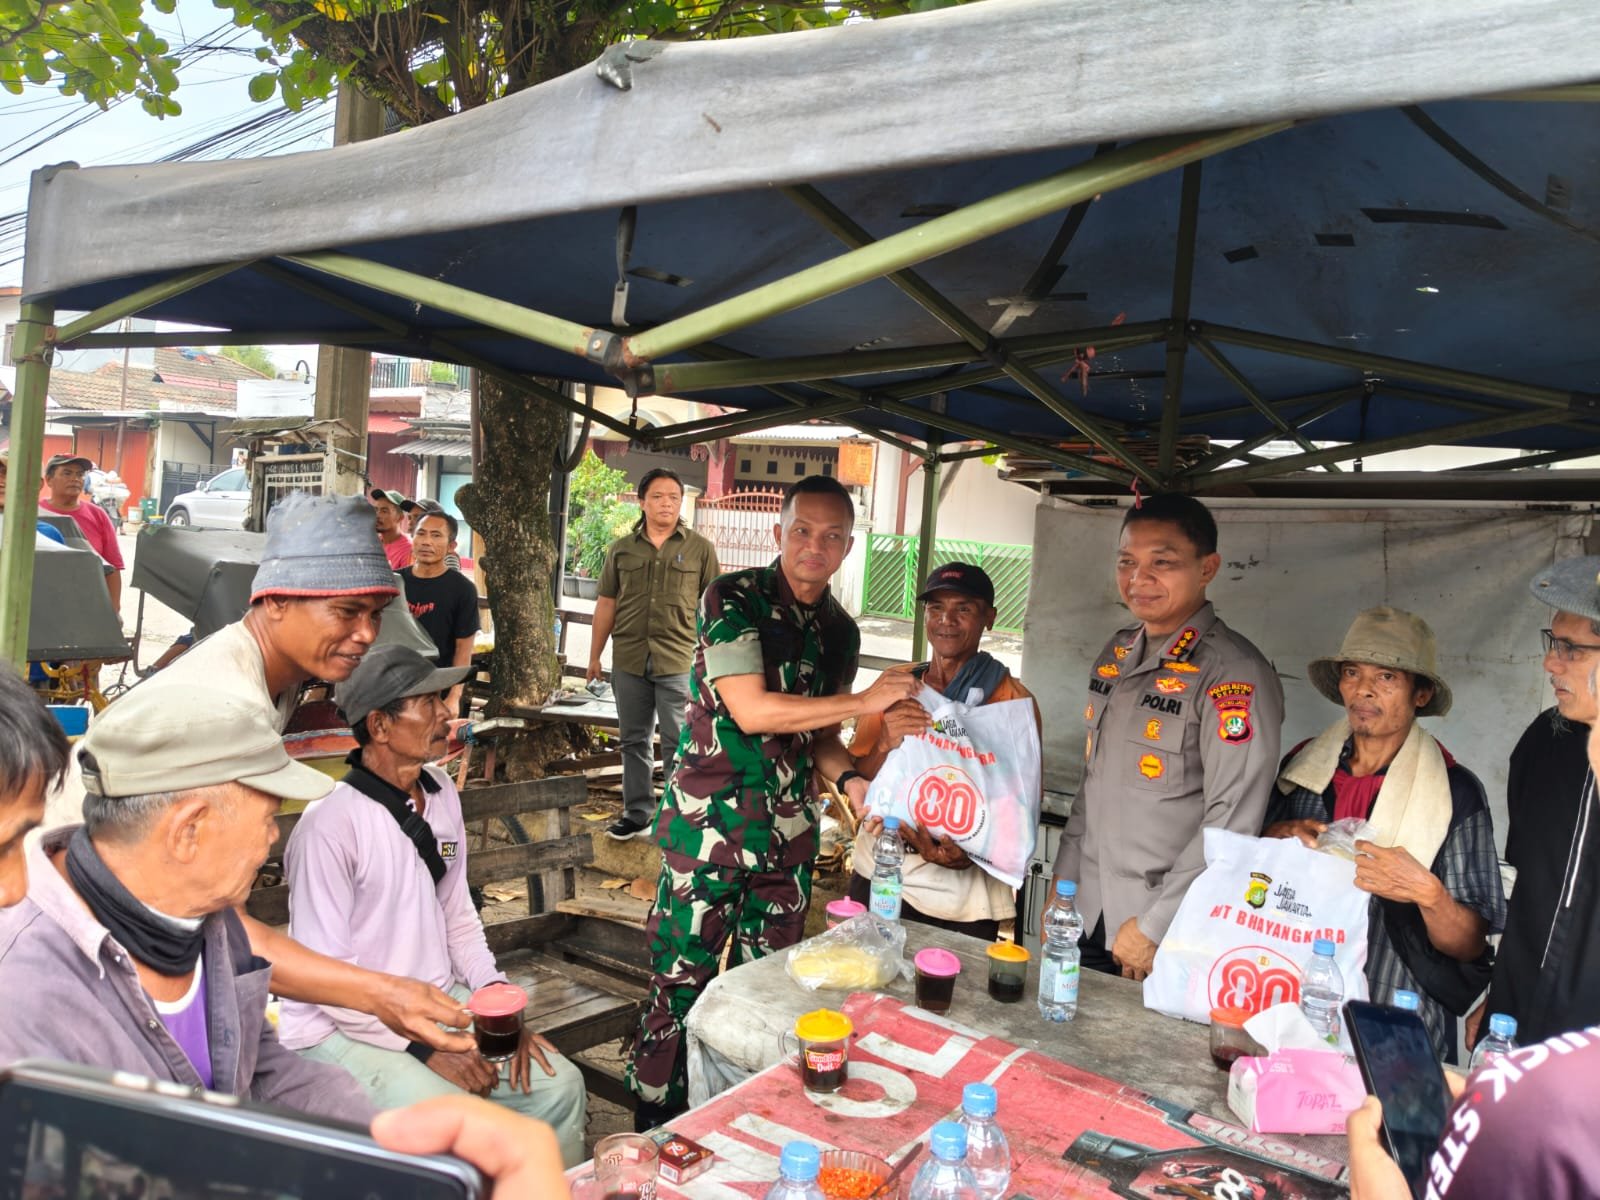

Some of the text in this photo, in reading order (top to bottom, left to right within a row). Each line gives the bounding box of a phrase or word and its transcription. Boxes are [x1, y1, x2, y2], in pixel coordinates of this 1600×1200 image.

[1141, 694, 1182, 716] POLRI
[914, 775, 977, 836] 80
[1273, 881, 1296, 900] JAGA
[1235, 909, 1346, 944] BHAYANGKARA
[1217, 958, 1301, 1014] 80
[1203, 1120, 1332, 1169] MOTUL
